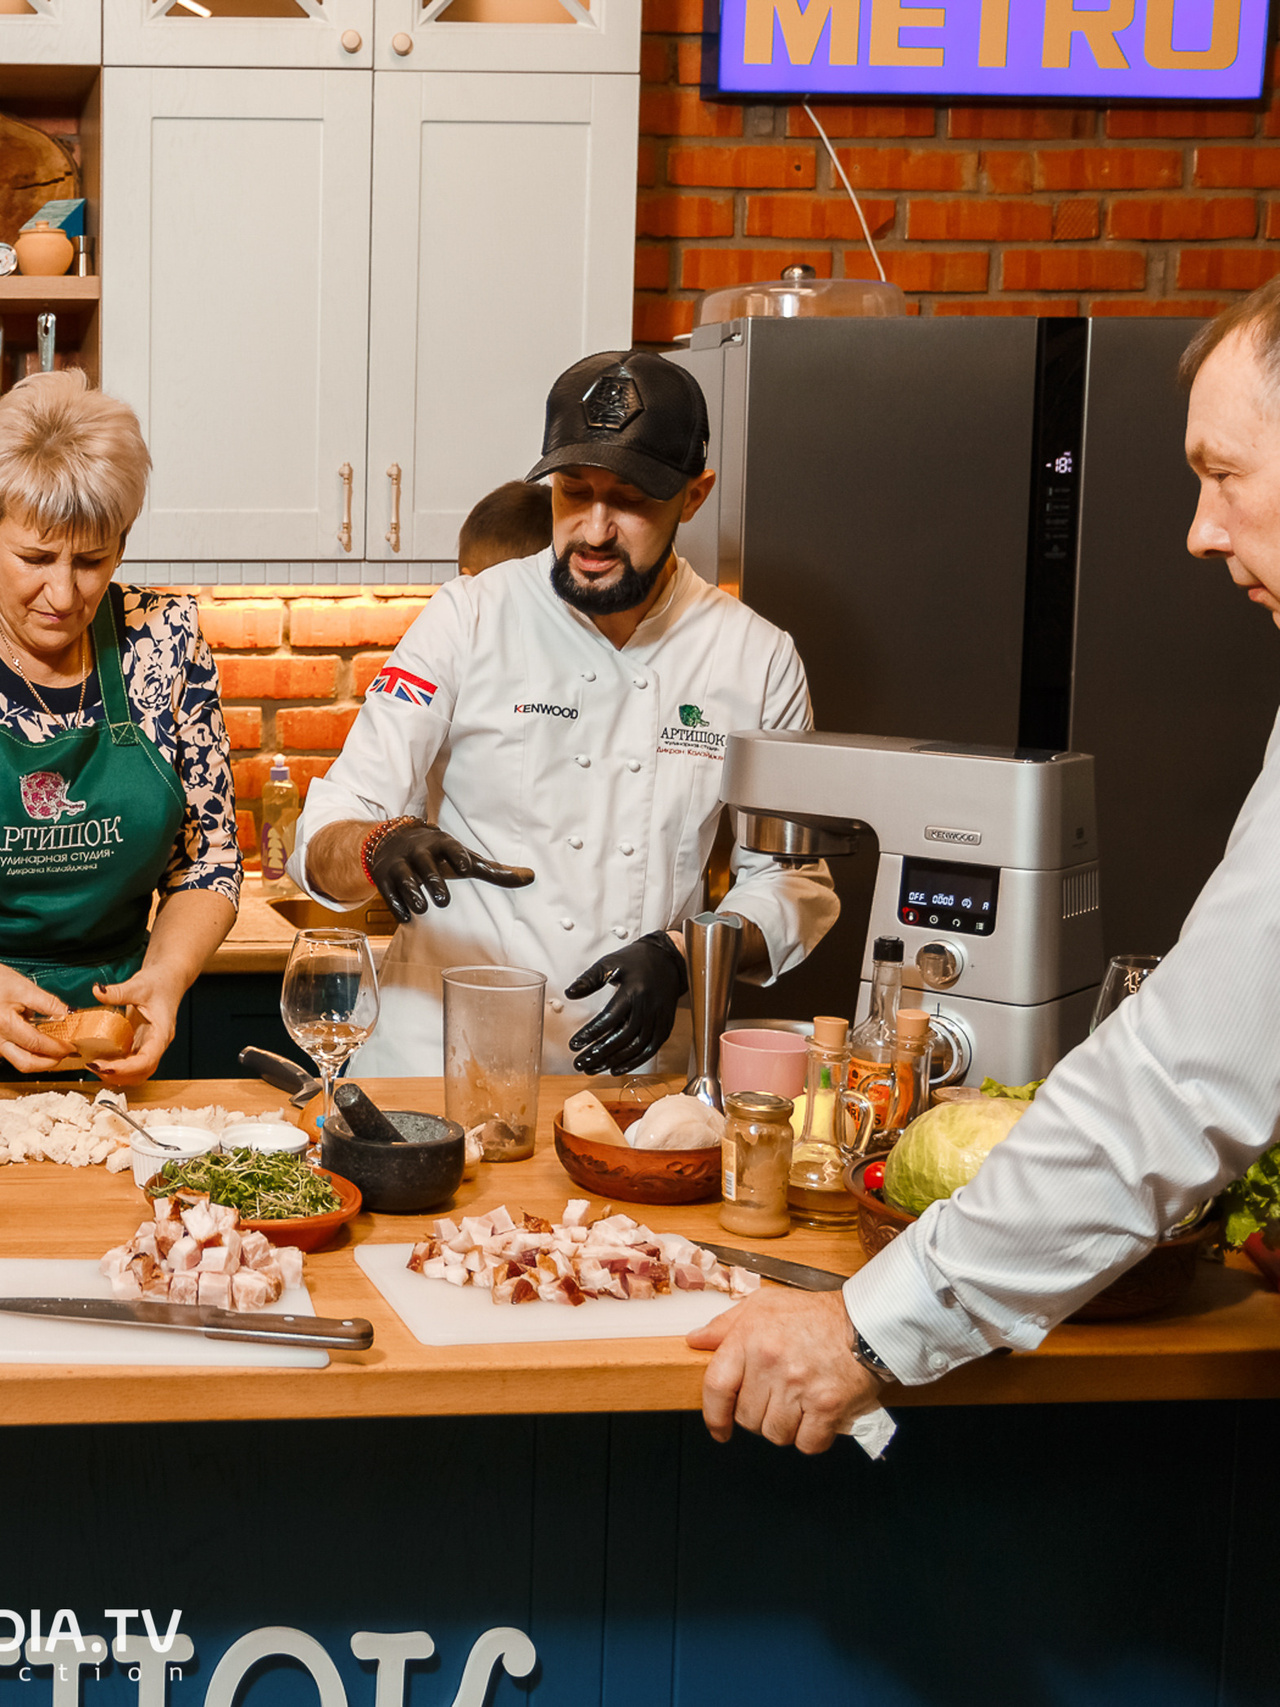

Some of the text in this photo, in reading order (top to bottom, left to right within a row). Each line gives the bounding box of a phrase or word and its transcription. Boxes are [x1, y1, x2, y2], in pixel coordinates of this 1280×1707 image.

[742, 0, 1242, 71] METRO
[513, 703, 579, 720] KENWOOD
[660, 726, 726, 747] АРТИШОК
[930, 829, 975, 842] KENWOOD
[70, 848, 111, 863] студия
[6, 867, 45, 876] Дикрана
[908, 891, 925, 901] OFF
